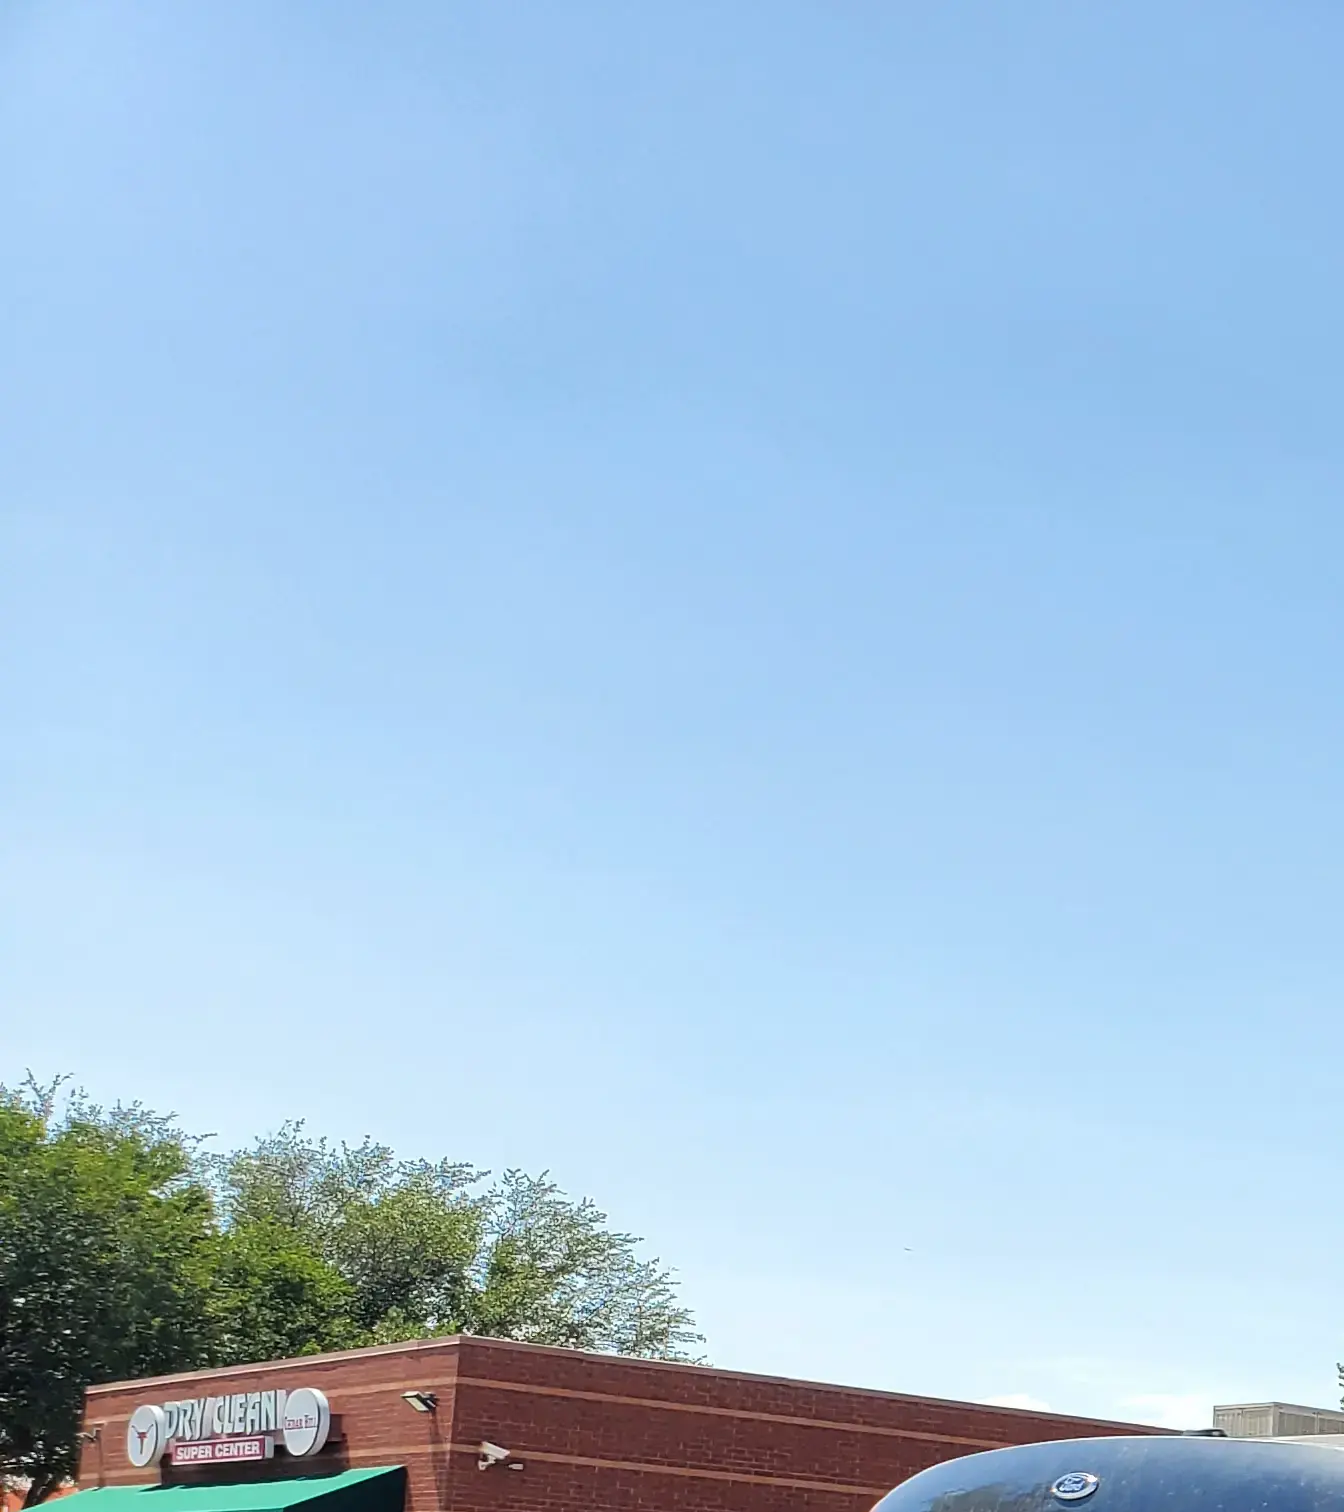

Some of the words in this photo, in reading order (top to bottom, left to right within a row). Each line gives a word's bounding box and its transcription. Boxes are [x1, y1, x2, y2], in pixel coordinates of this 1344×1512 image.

[164, 1397, 213, 1440] DRY
[212, 1390, 286, 1435] CLEAN
[176, 1444, 211, 1460] SUPER
[214, 1440, 261, 1458] CENTER
